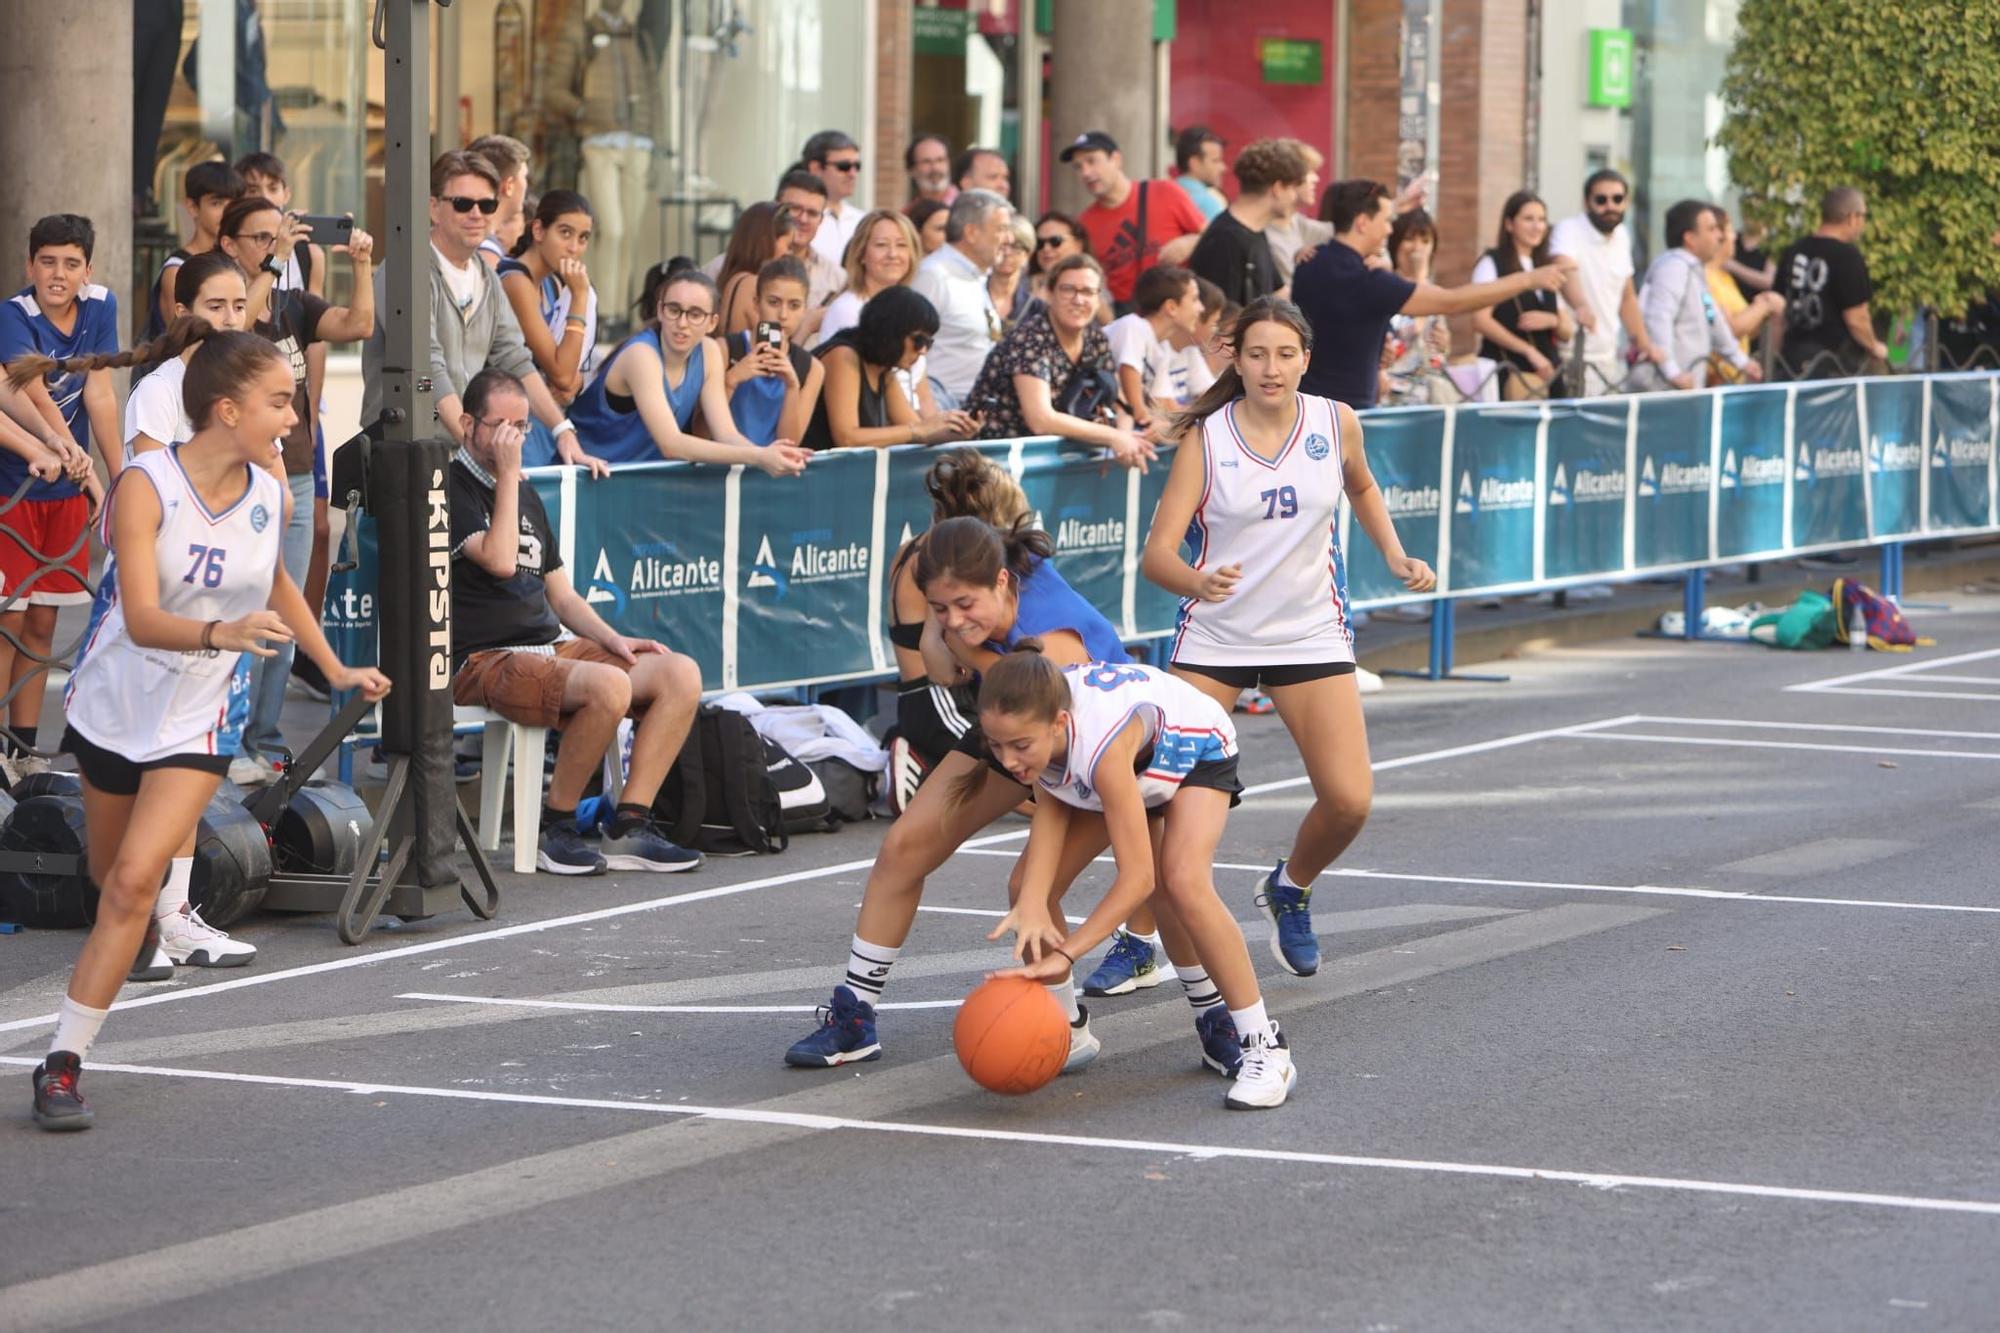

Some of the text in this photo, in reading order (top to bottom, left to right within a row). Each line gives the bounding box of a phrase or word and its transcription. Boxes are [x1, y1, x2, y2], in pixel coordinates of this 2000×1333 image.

[1261, 485, 1298, 520] 79
[1384, 485, 1440, 512] Alicante
[1479, 477, 1534, 503] Alicante
[1056, 518, 1124, 548] Alicante
[183, 543, 226, 588] 76
[631, 556, 720, 591] Alicante
[792, 542, 868, 576] Alicante
